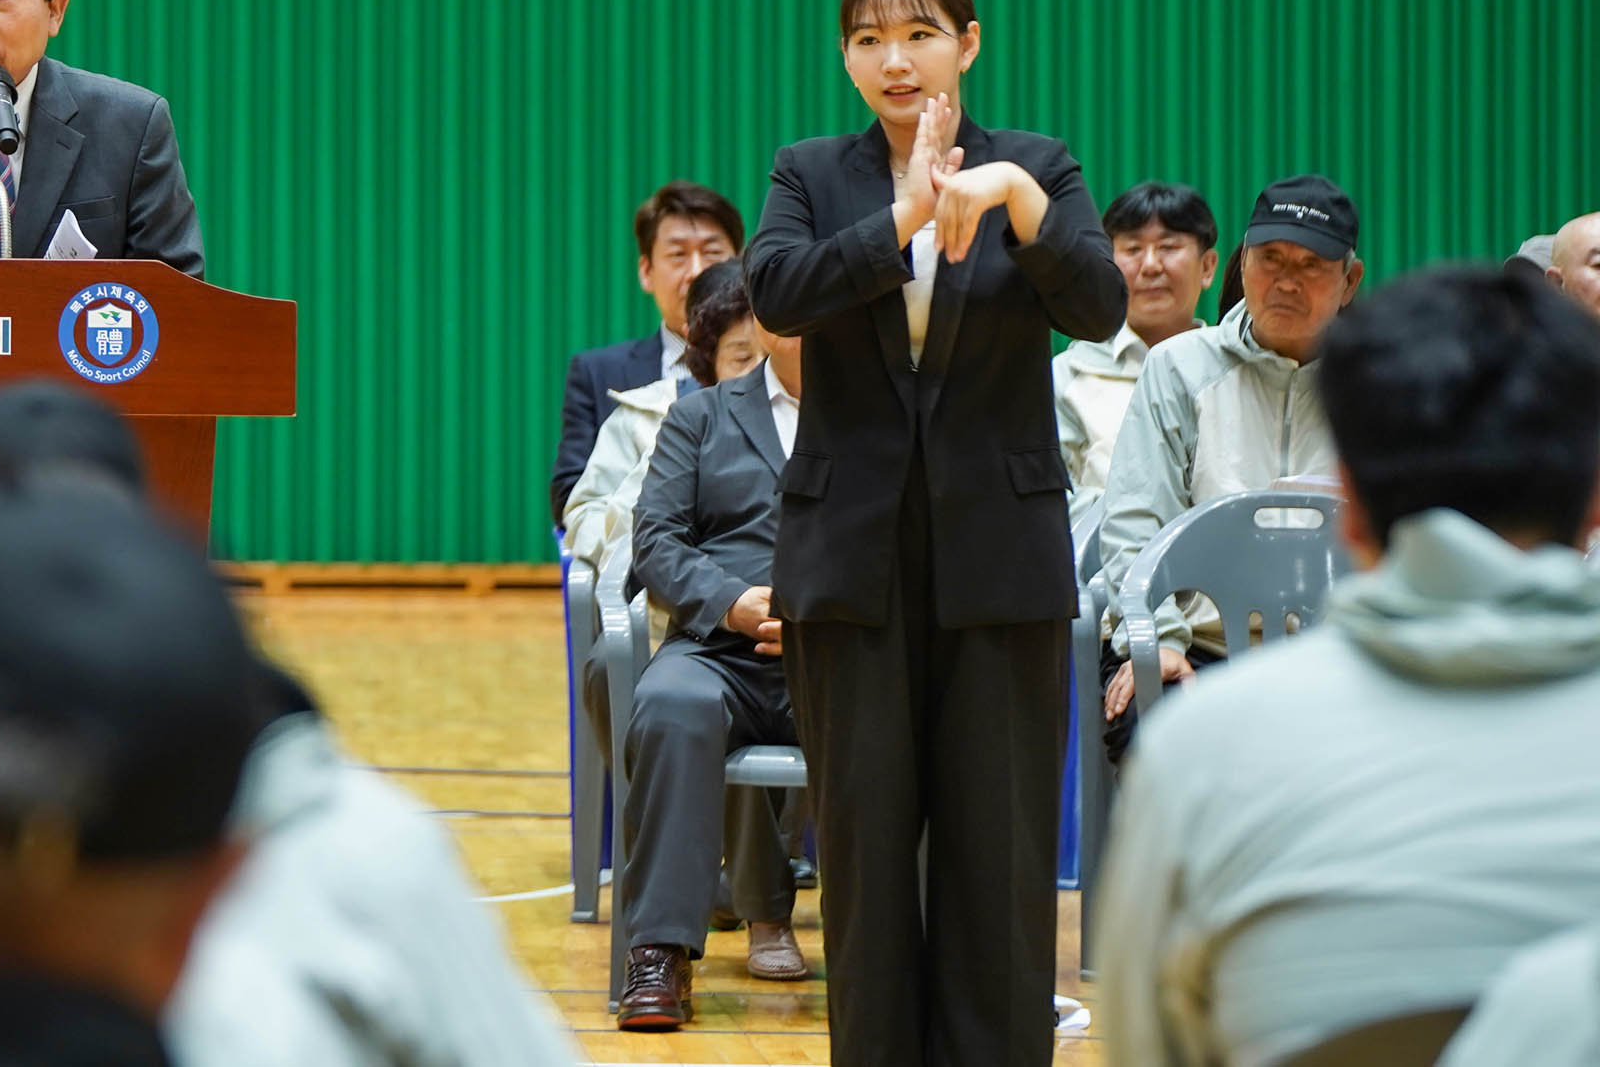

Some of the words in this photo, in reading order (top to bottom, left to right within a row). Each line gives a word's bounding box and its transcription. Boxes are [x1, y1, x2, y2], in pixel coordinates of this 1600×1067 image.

[69, 285, 149, 314] 목포시체육회
[96, 328, 124, 356] 體
[67, 349, 94, 377] Mokpo
[94, 370, 122, 382] Sport
[122, 349, 152, 377] Council
